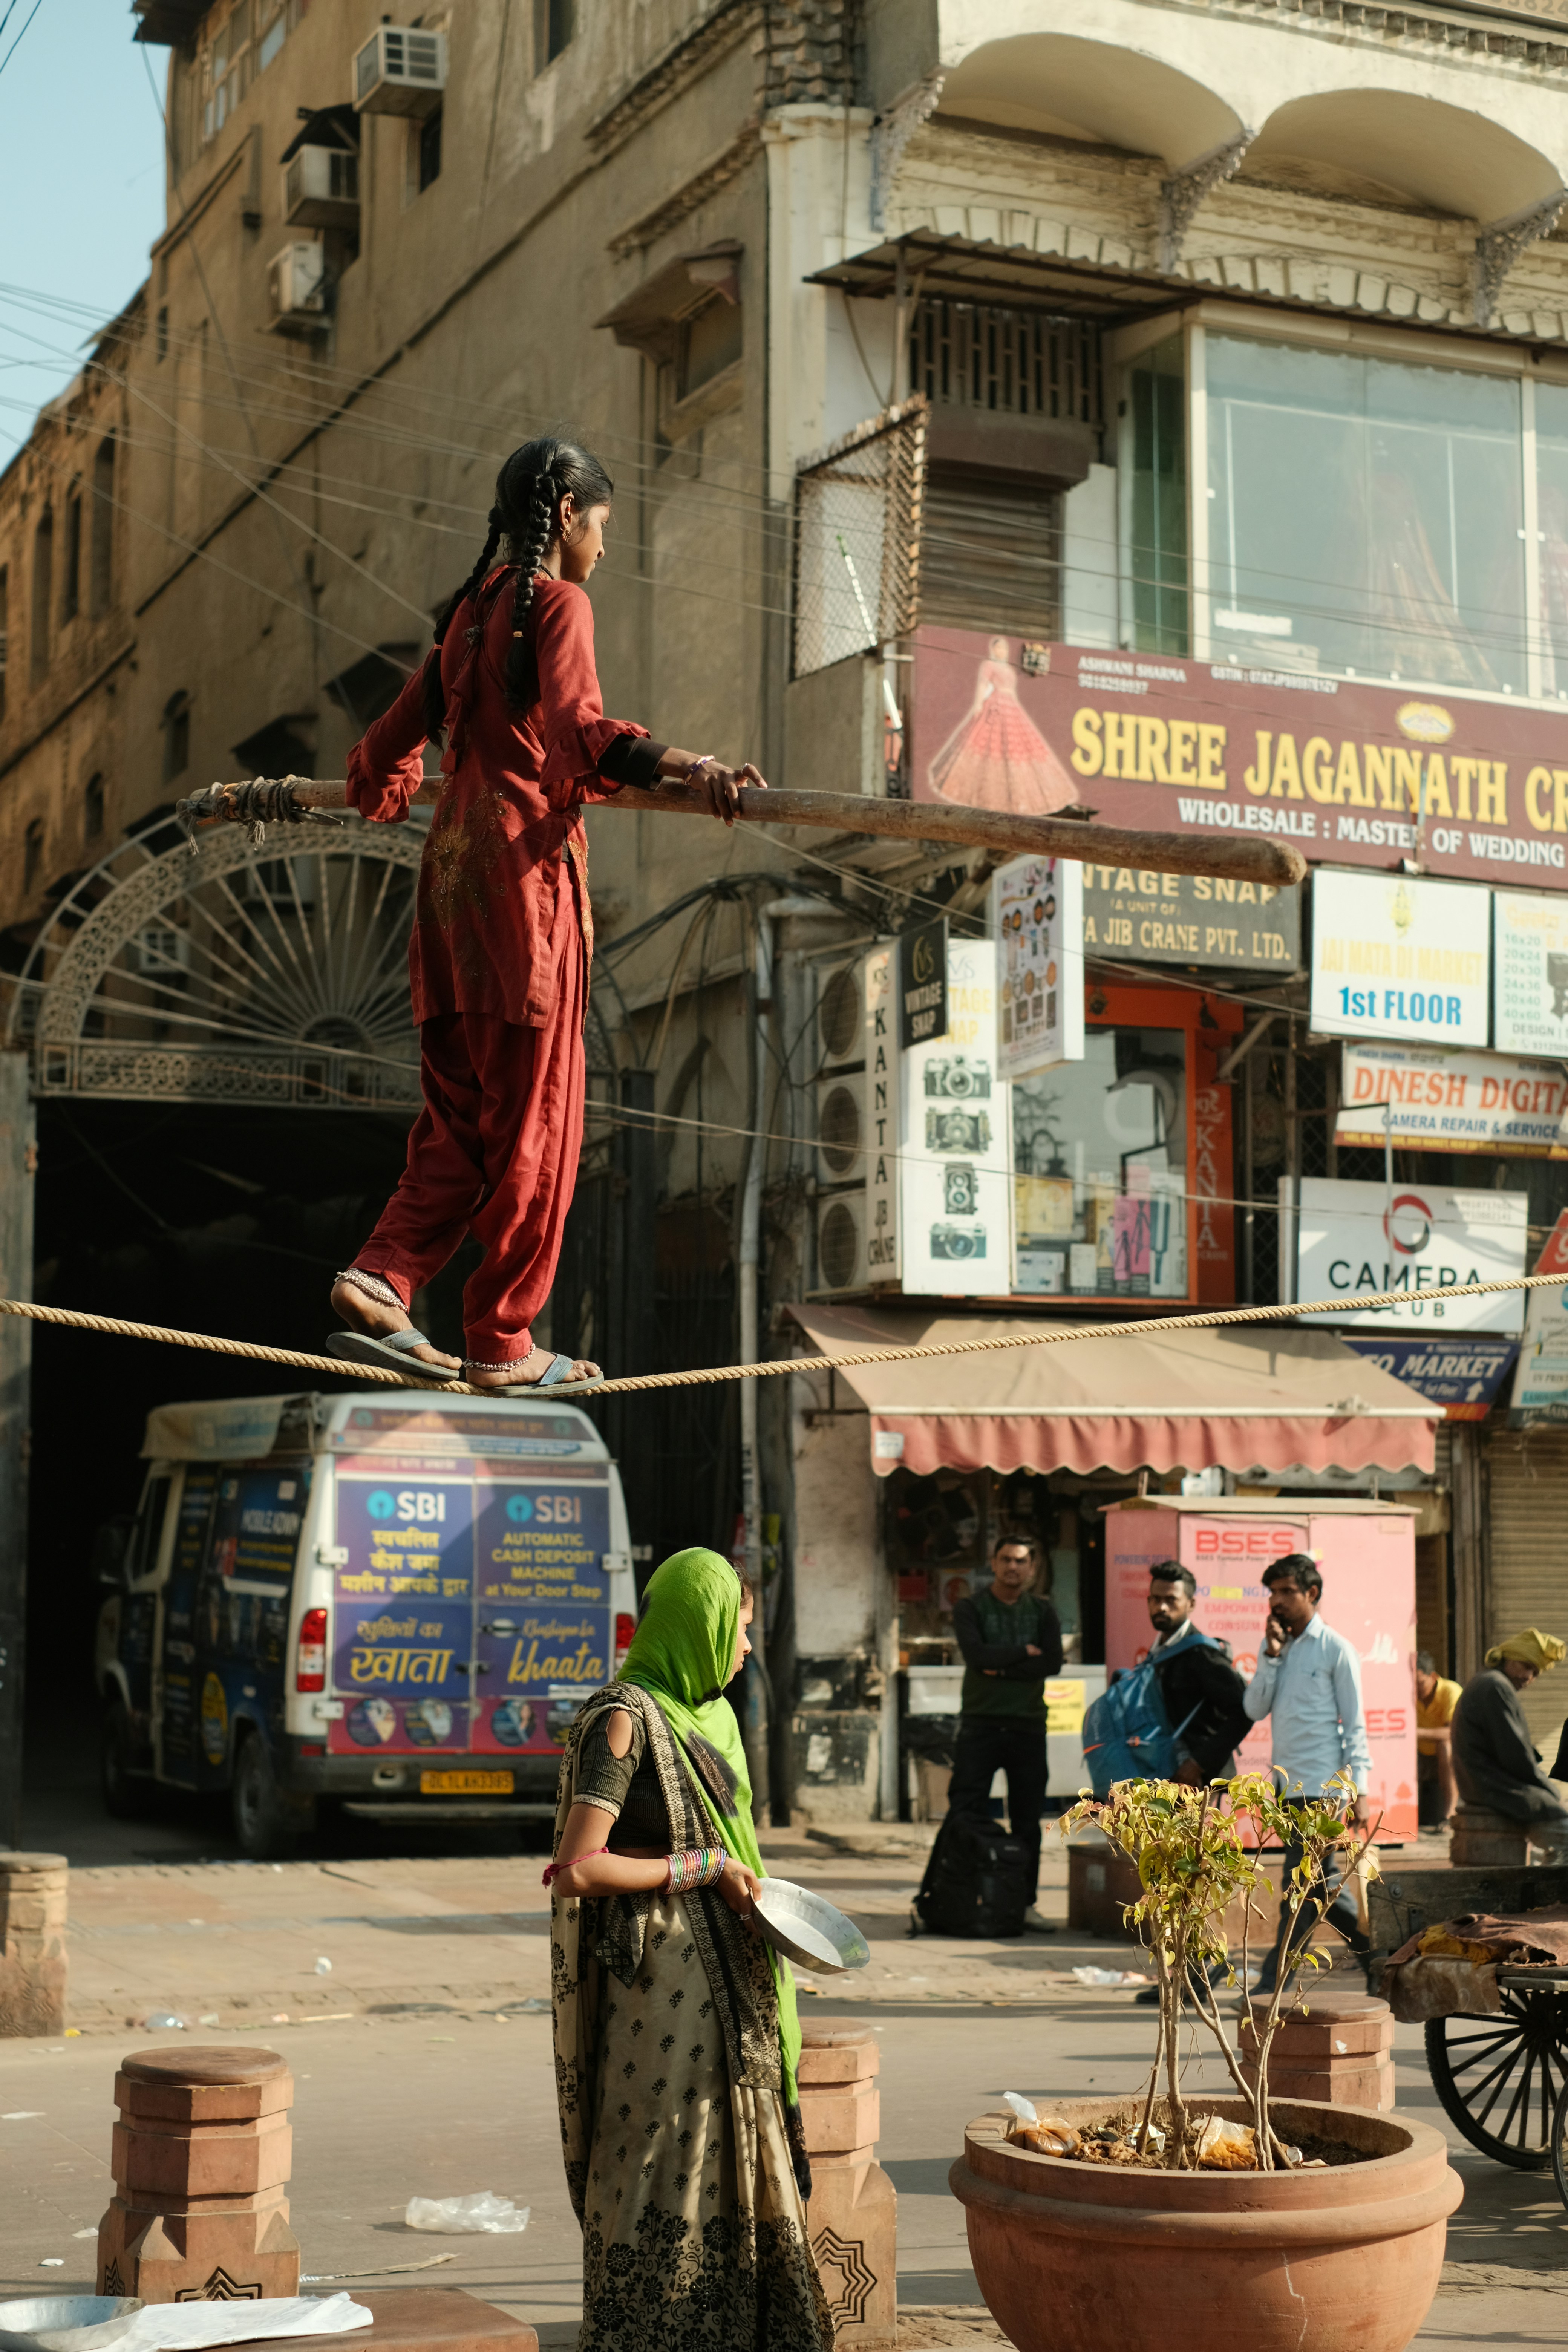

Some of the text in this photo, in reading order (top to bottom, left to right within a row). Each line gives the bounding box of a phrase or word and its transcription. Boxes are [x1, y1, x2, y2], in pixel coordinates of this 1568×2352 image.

[1135, 663, 1187, 683] SHARMA
[1070, 706, 1228, 790] SHREE
[1244, 729, 1508, 825] JAGANNATH
[1178, 797, 1316, 838] WHOLESALE
[1432, 828, 1462, 854] OF
[1469, 833, 1566, 868] WEDDING
[1082, 864, 1181, 898] NTAGE
[1103, 917, 1133, 946] JIB
[1139, 921, 1199, 952] CRANE
[1205, 927, 1245, 956] PVT.
[1252, 931, 1291, 960] LTD.
[1417, 947, 1483, 986] MARKET
[948, 986, 992, 1015] TAGE
[1339, 986, 1462, 1026] 1st FLOOR
[935, 1020, 979, 1046] NAP
[1513, 1023, 1554, 1037] DESIGN
[1352, 1067, 1468, 1107] DINESH
[1382, 1111, 1559, 1139] CAMERA REPAIR & SERVICE
[1328, 1261, 1484, 1297] CAMERA
[1398, 1355, 1505, 1378] MARKET
[397, 1491, 446, 1522] SBI
[536, 1495, 581, 1524] SBI
[502, 1532, 584, 1547] AUTOMATIC
[1196, 1531, 1294, 1553] BSES
[492, 1549, 595, 1564] CASH DEPOSIT
[511, 1566, 576, 1580] MACHINE
[485, 1584, 602, 1600] at Your Door Step
[419, 1622, 443, 1638] का
[350, 1647, 455, 1684] खाता
[507, 1638, 605, 1684] khaata
[1364, 1708, 1406, 1732] ES
